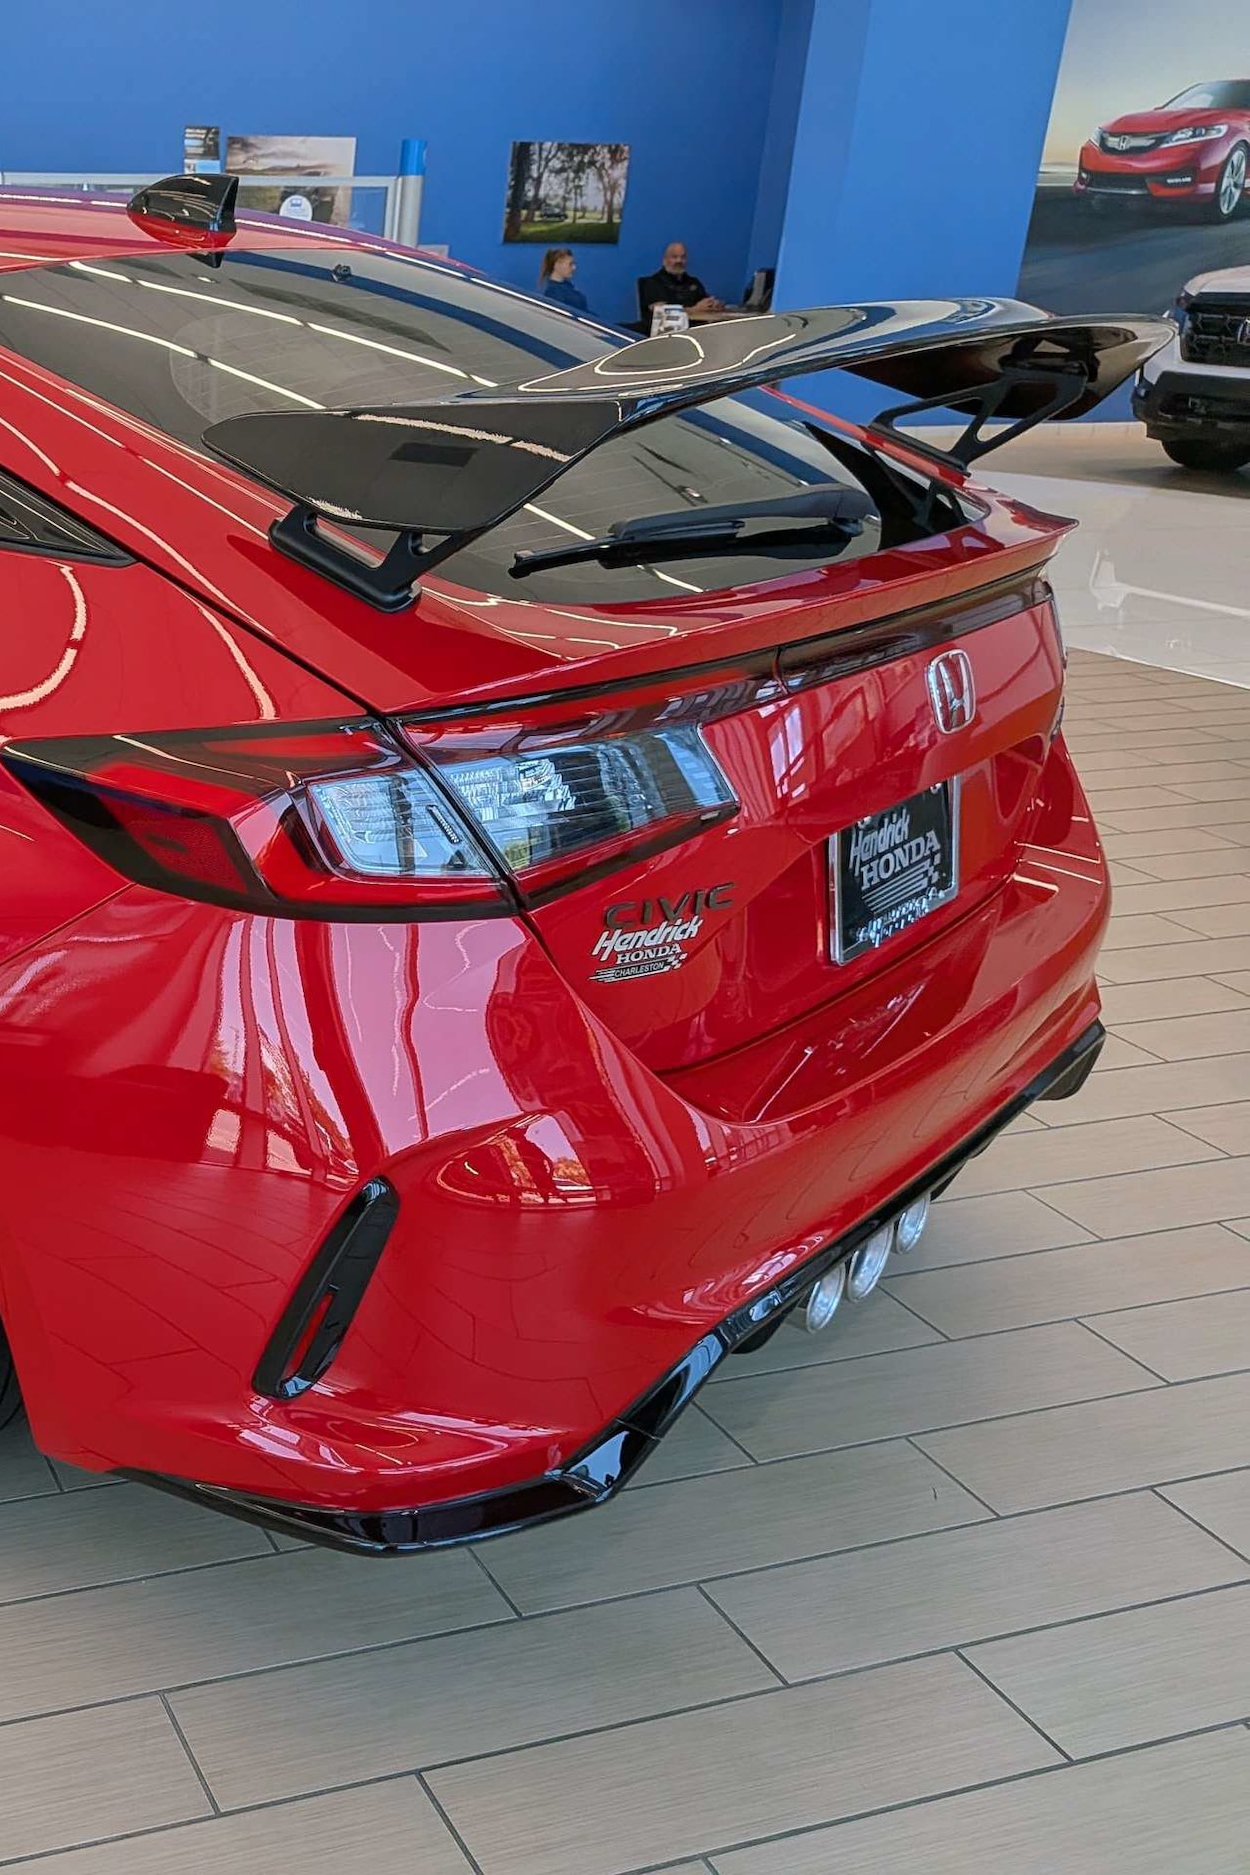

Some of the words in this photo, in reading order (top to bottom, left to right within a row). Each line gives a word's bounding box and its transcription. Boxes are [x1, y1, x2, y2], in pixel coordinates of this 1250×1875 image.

[849, 807, 910, 877] Hendrick
[860, 829, 941, 891] HONDA
[604, 882, 735, 929] CIVIC
[591, 914, 704, 962] Hendrick
[616, 943, 682, 965] HONDA
[614, 962, 665, 978] CHARLESTON
